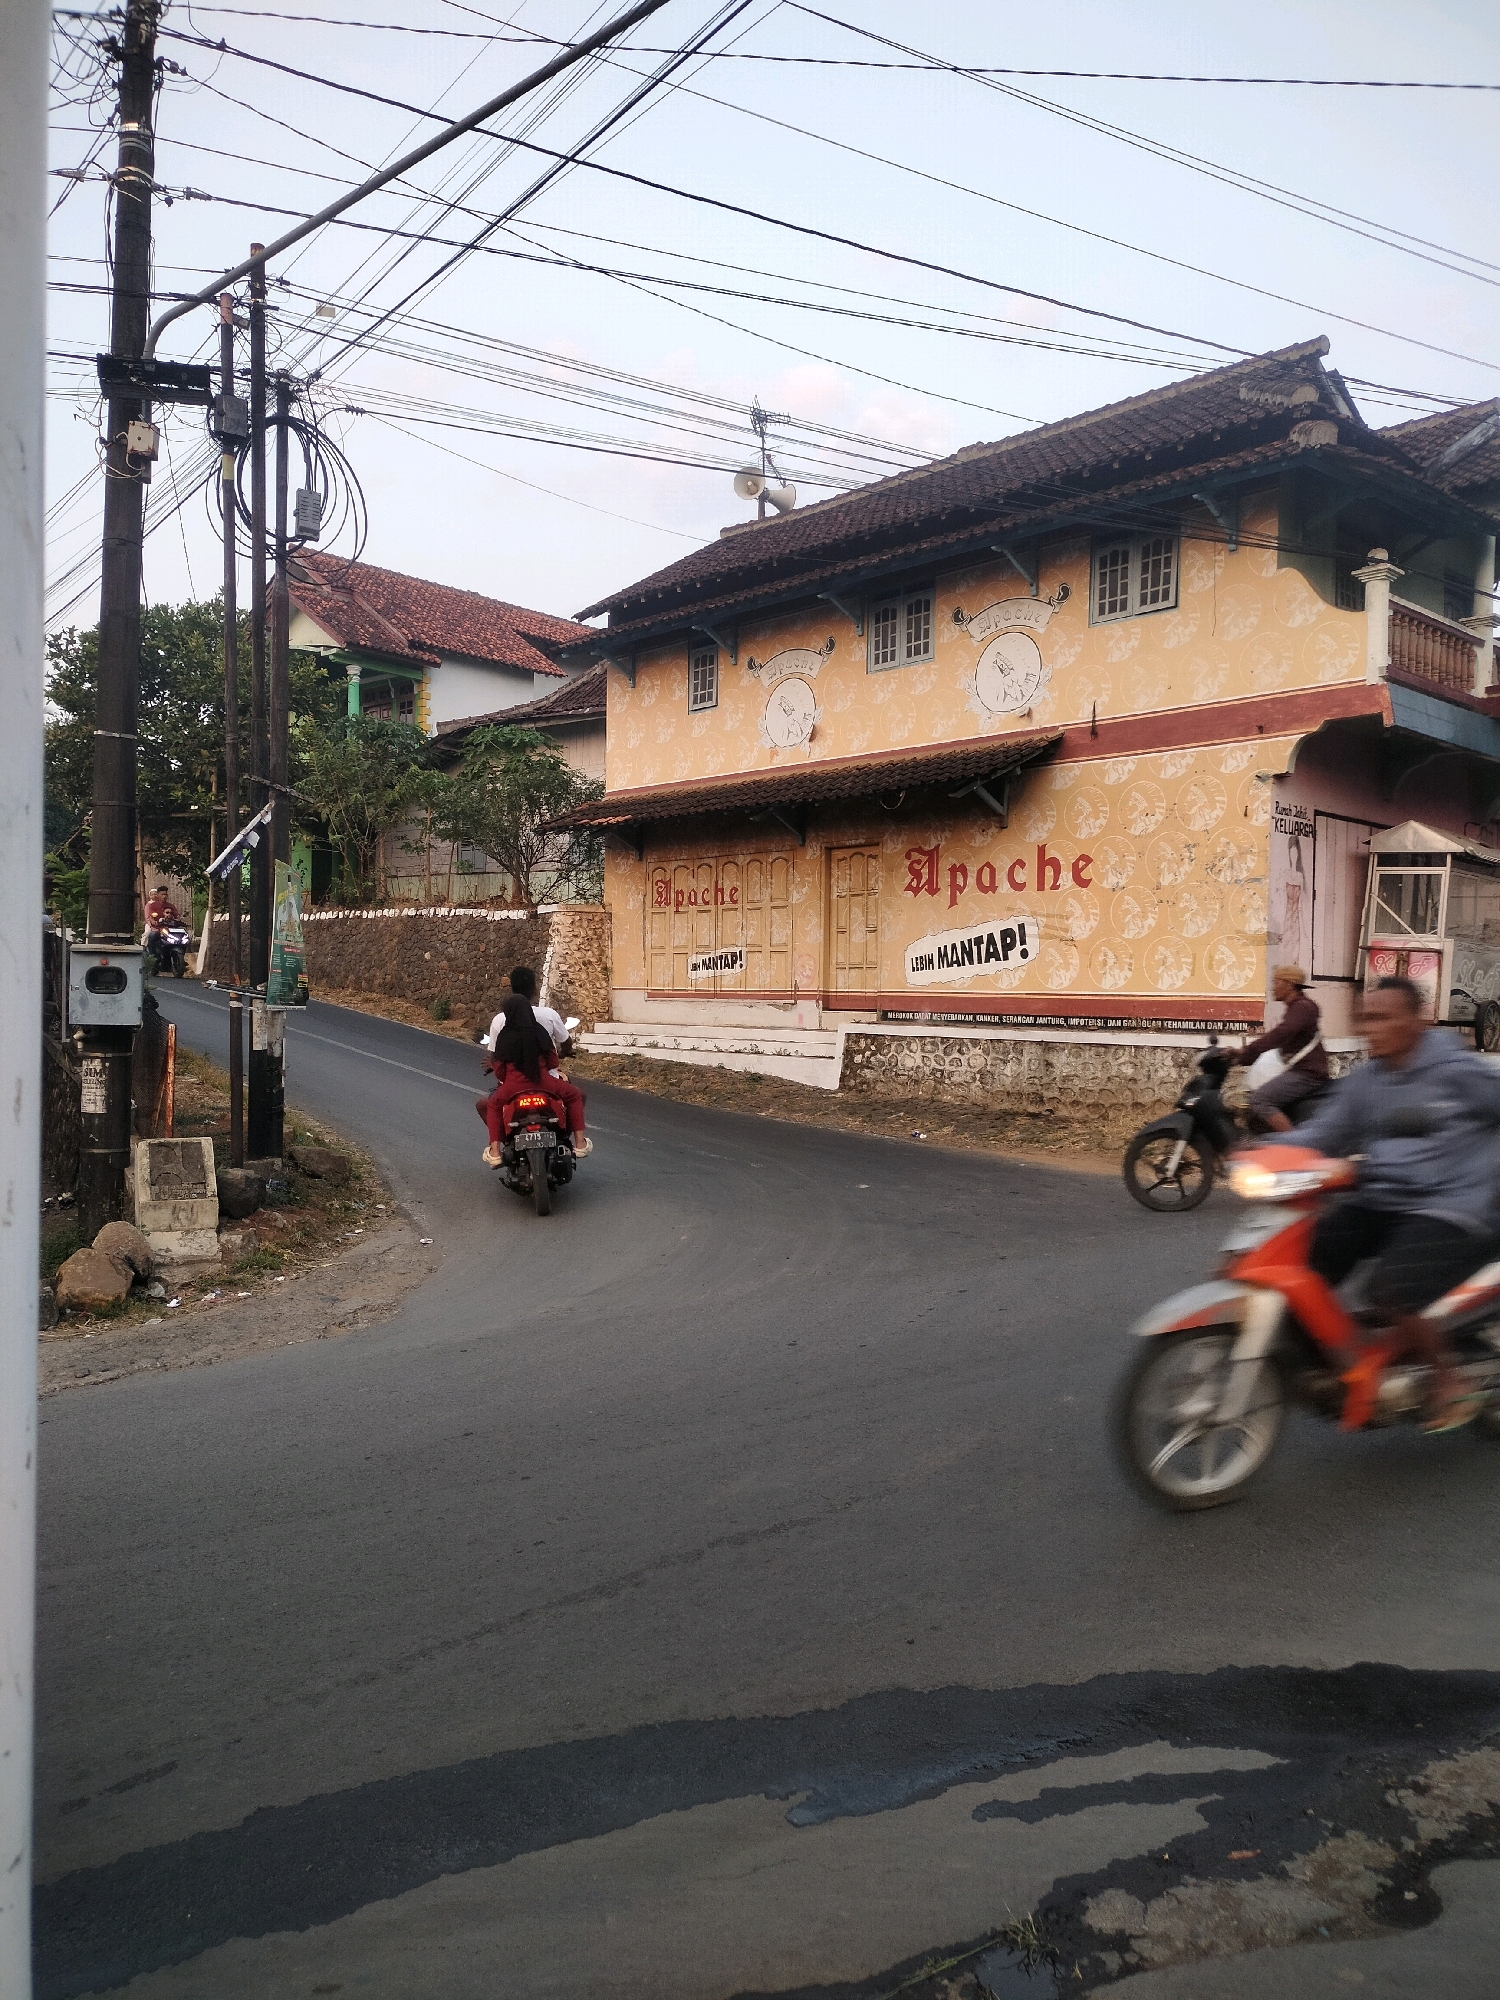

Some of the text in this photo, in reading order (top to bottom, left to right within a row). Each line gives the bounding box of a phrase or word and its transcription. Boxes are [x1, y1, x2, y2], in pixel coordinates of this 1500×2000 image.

[1275, 800, 1292, 816] Rumah
[903, 843, 1094, 910] Apache
[654, 878, 739, 912] Apache
[702, 950, 743, 971] MANTAP!
[910, 923, 1029, 972] LEBIH MANTAP!
[887, 1012, 913, 1020] MEROKOK
[976, 1014, 1000, 1024] KANKER,
[1002, 1015, 1034, 1024] SERANGAN
[1035, 1016, 1067, 1026] JANTUNG,
[1107, 1018, 1121, 1027] DAN
[1163, 1020, 1206, 1030] KEHAMILAN
[1207, 1022, 1223, 1030] DAN
[1224, 1022, 1248, 1031] JANIN
